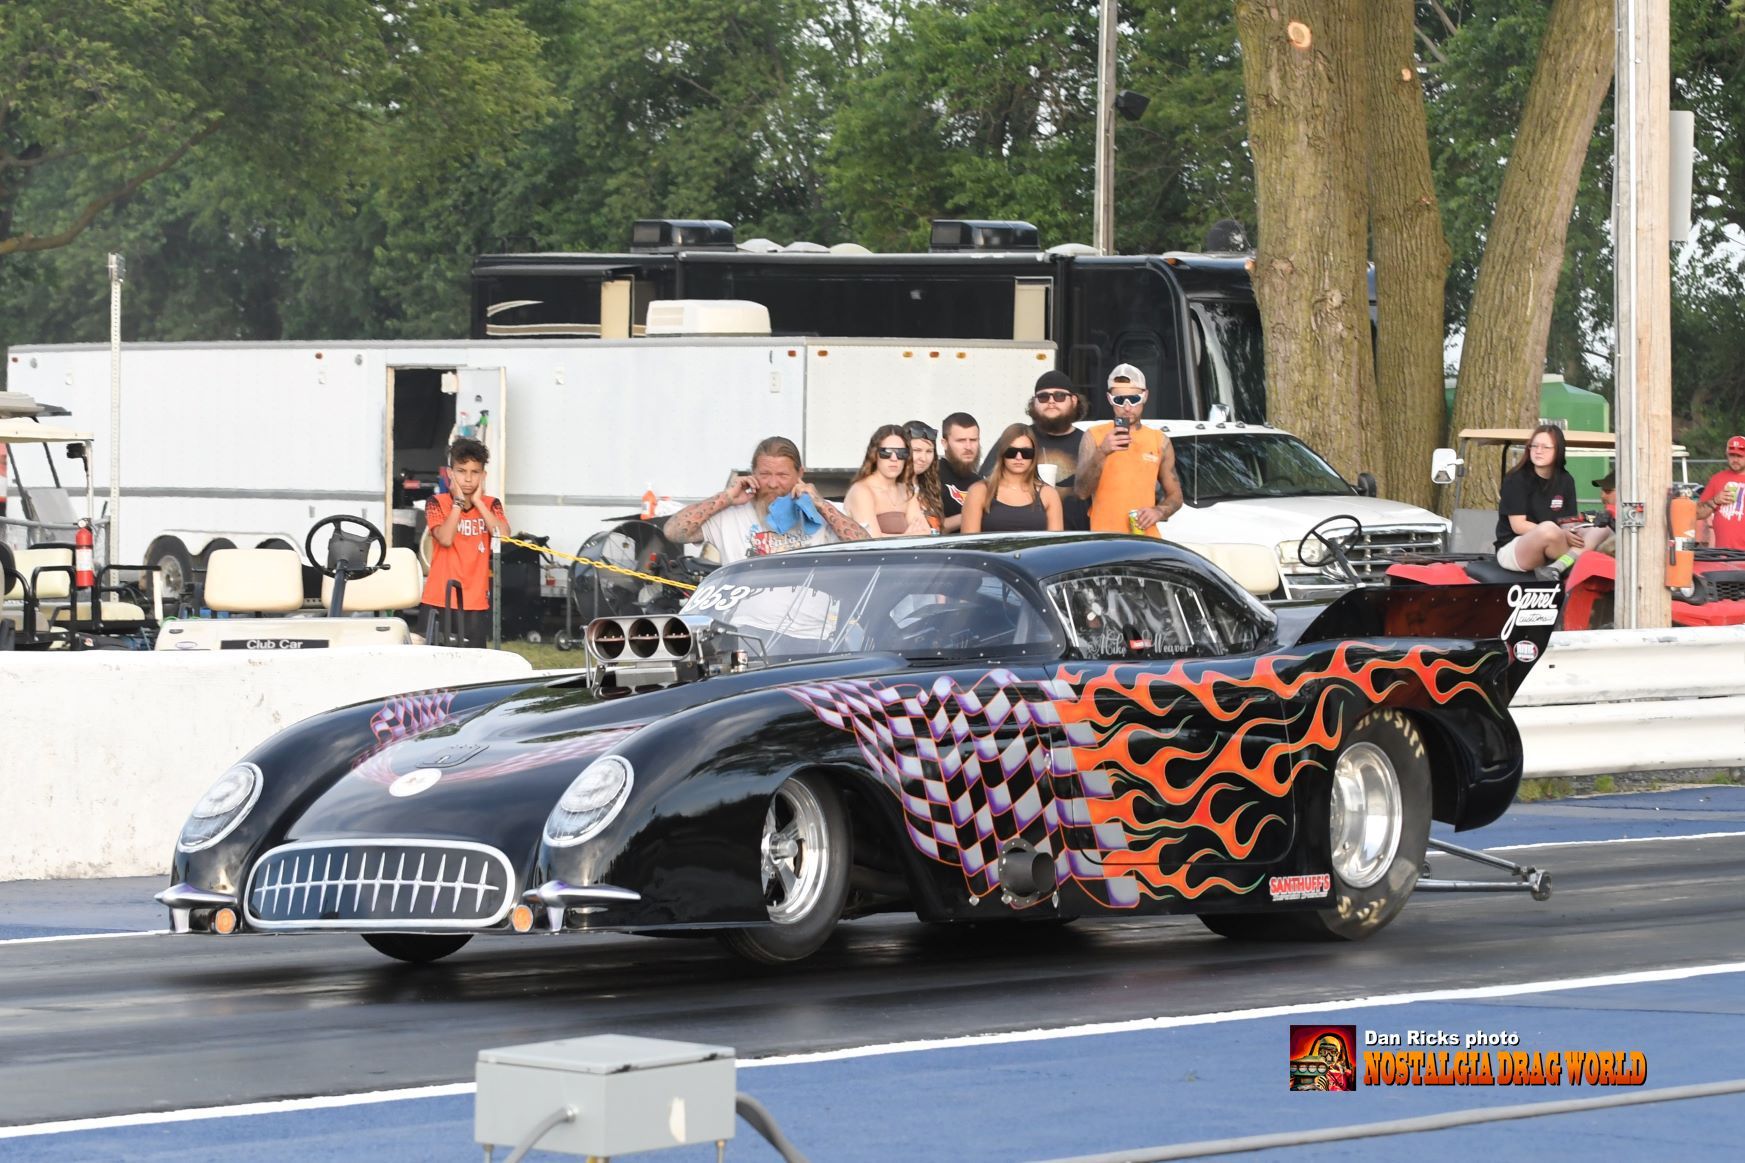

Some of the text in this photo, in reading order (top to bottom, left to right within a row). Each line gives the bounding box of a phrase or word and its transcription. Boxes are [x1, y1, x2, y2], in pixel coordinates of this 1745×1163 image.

[246, 639, 303, 649] Club Car
[1270, 874, 1330, 895] SANTHUFF'S
